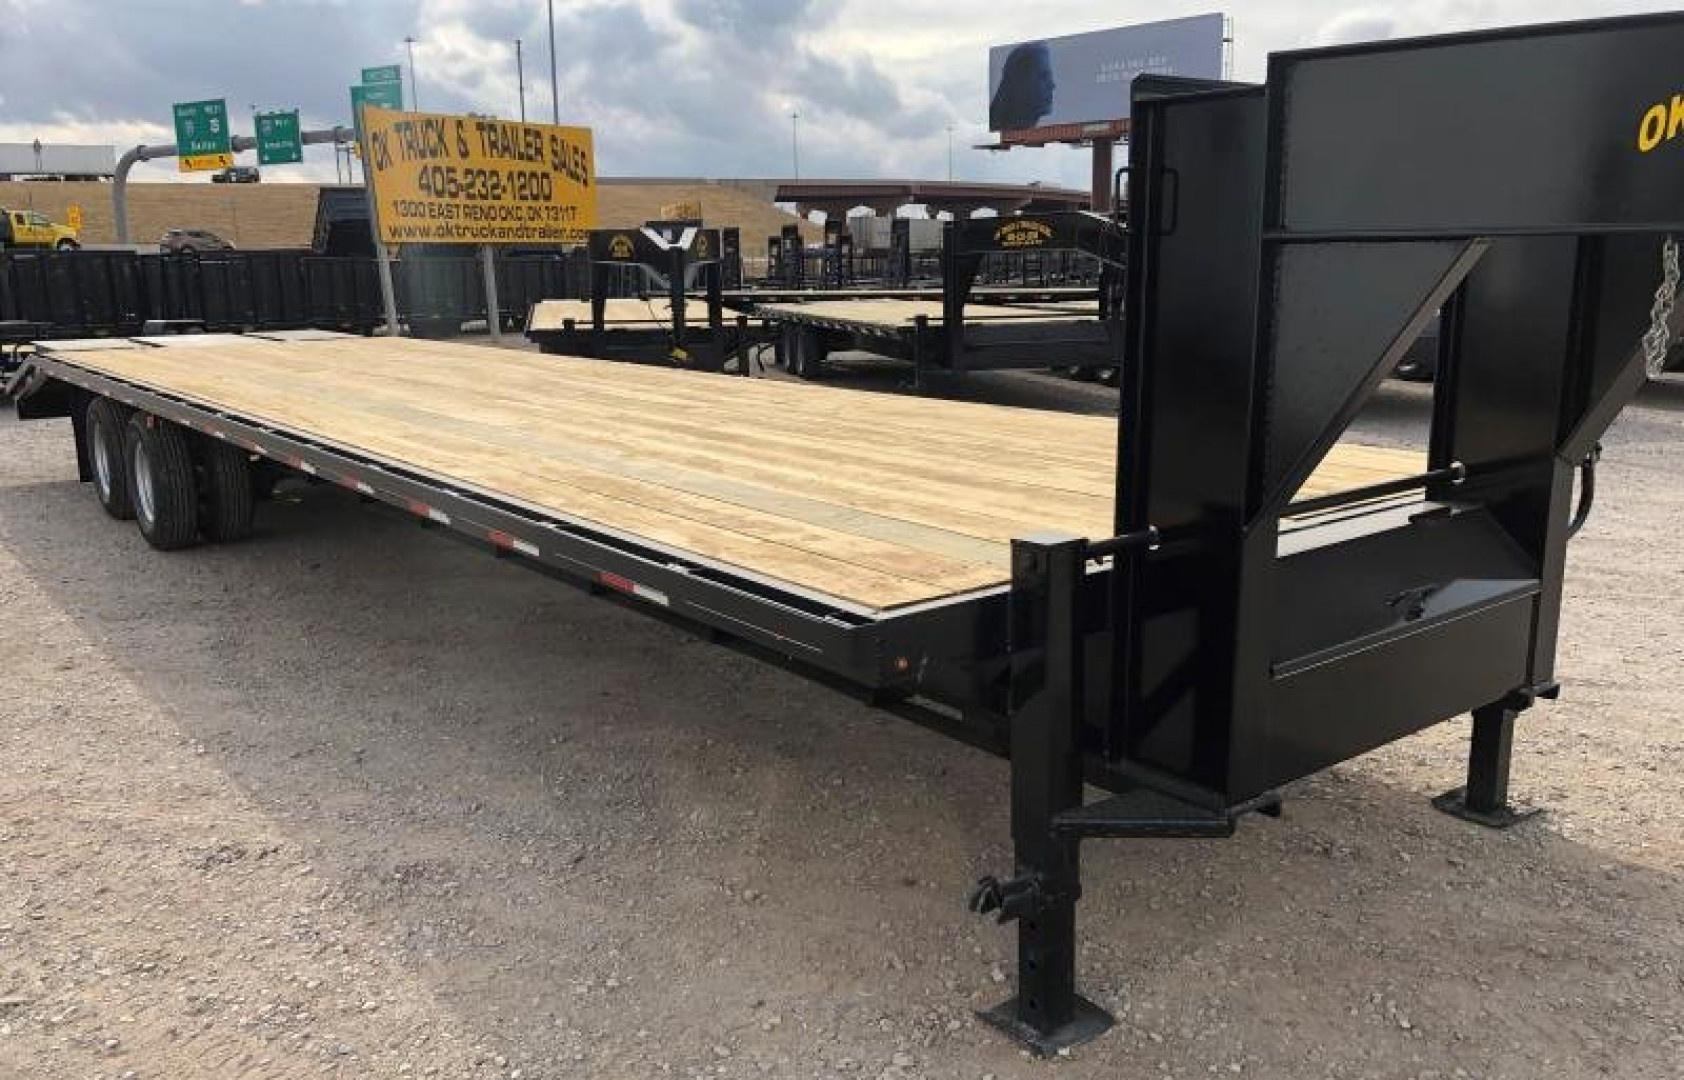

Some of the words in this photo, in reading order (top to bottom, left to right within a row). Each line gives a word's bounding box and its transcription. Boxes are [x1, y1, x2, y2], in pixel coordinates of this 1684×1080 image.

[371, 127, 393, 172] OK
[393, 117, 450, 161] TRUCK
[475, 121, 545, 164] TRAILER
[550, 133, 589, 187] SALES
[418, 165, 553, 202] 405-232-1200
[393, 200, 426, 218] 1300
[428, 202, 461, 220] EAST
[463, 204, 498, 221] RENO
[528, 206, 543, 221] OK
